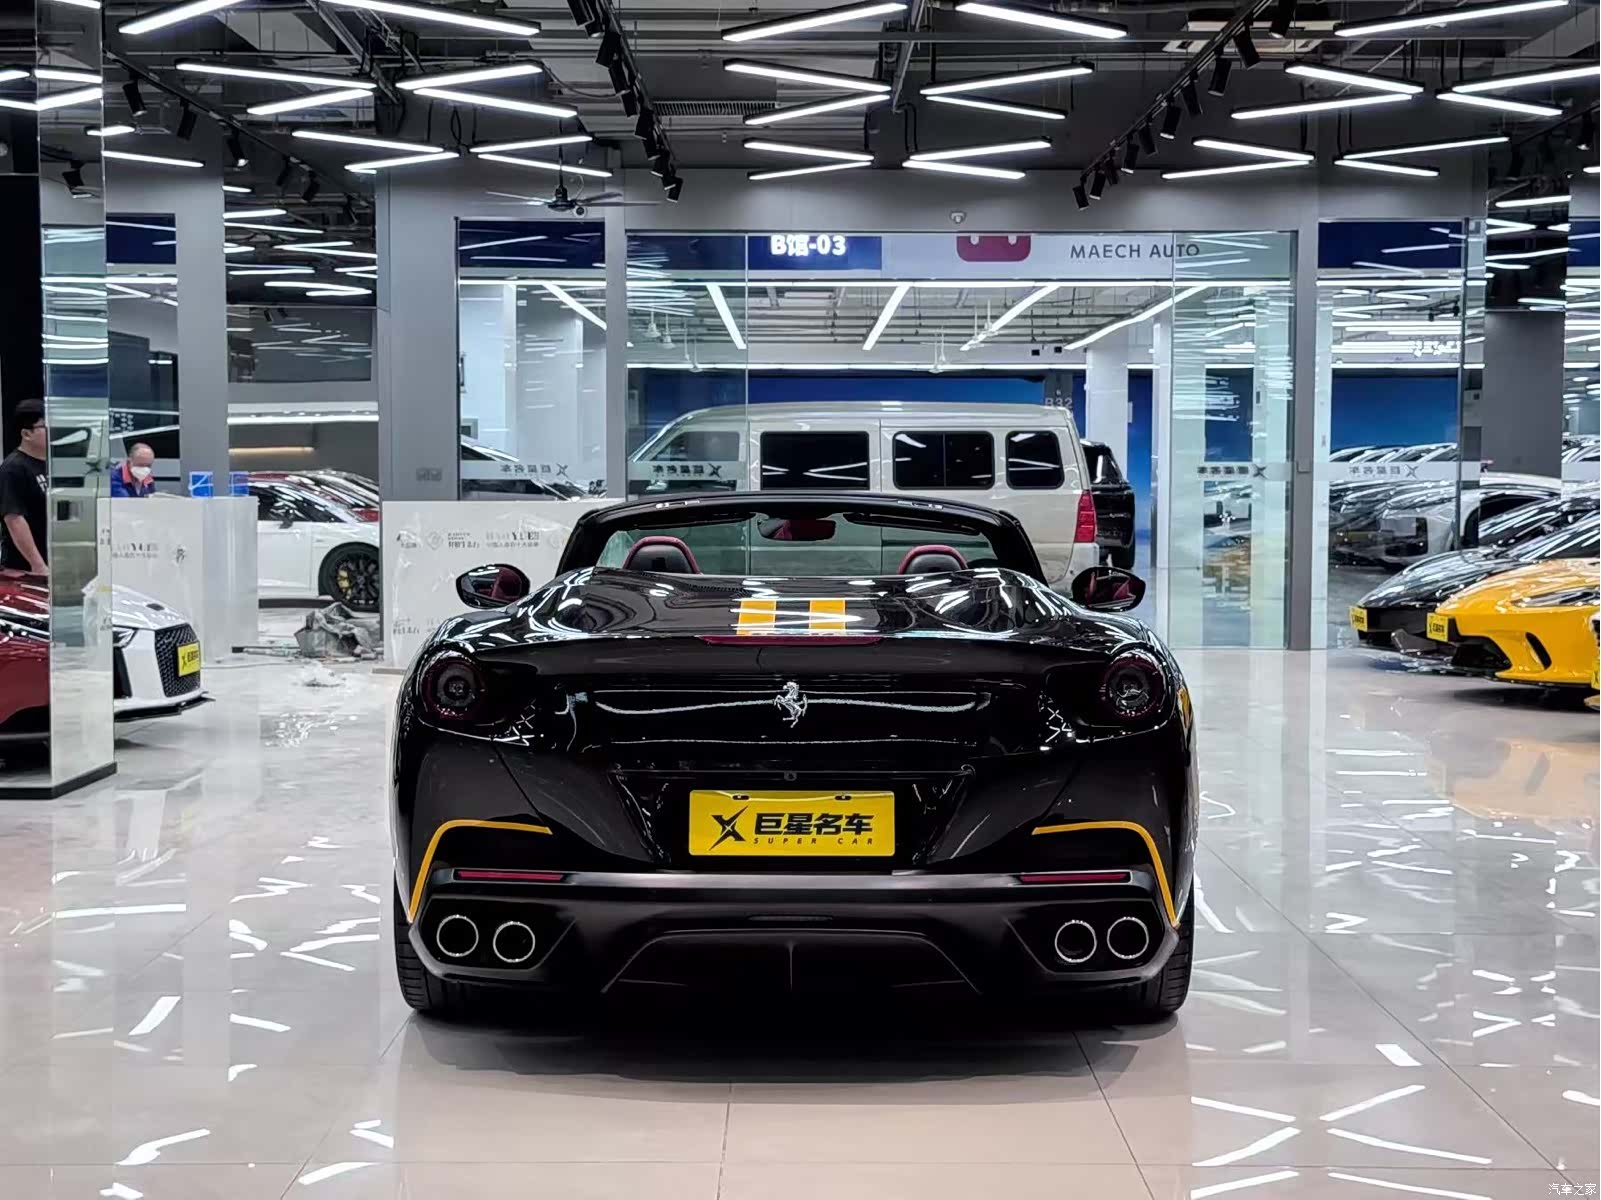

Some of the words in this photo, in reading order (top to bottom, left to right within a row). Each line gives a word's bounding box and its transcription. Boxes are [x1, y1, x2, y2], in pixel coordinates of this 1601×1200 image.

[1070, 244, 1141, 259] MAECH
[1149, 243, 1200, 258] AUTO
[754, 812, 875, 836] 巨星名车
[753, 837, 818, 845] SUPER
[837, 837, 874, 845] CAR
